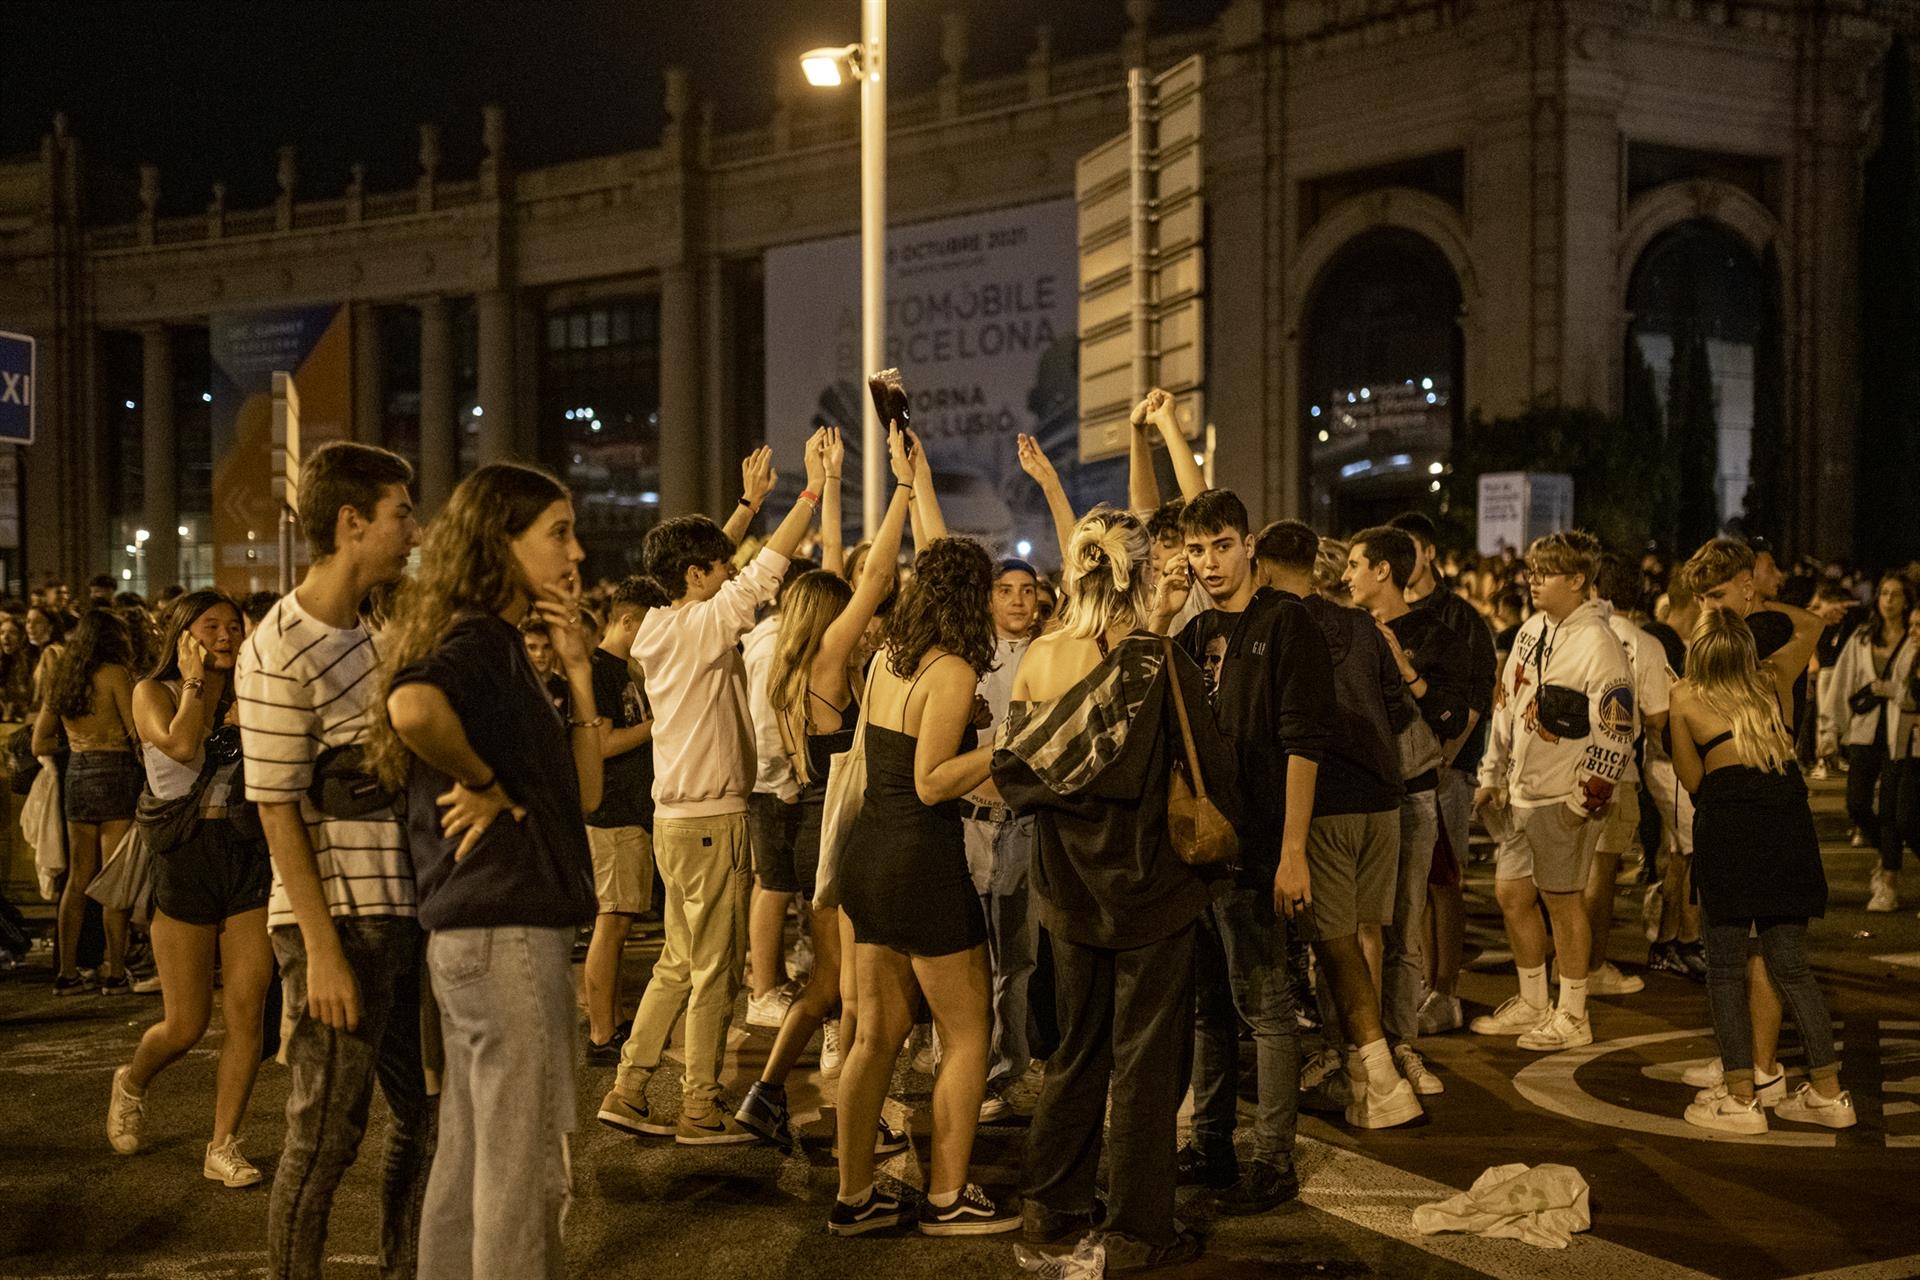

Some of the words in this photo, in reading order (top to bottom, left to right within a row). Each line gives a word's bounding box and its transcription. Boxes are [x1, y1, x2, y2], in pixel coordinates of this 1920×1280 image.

[2, 371, 30, 405] XI
[1586, 744, 1626, 767] CHICA
[1586, 758, 1621, 781] BULL
